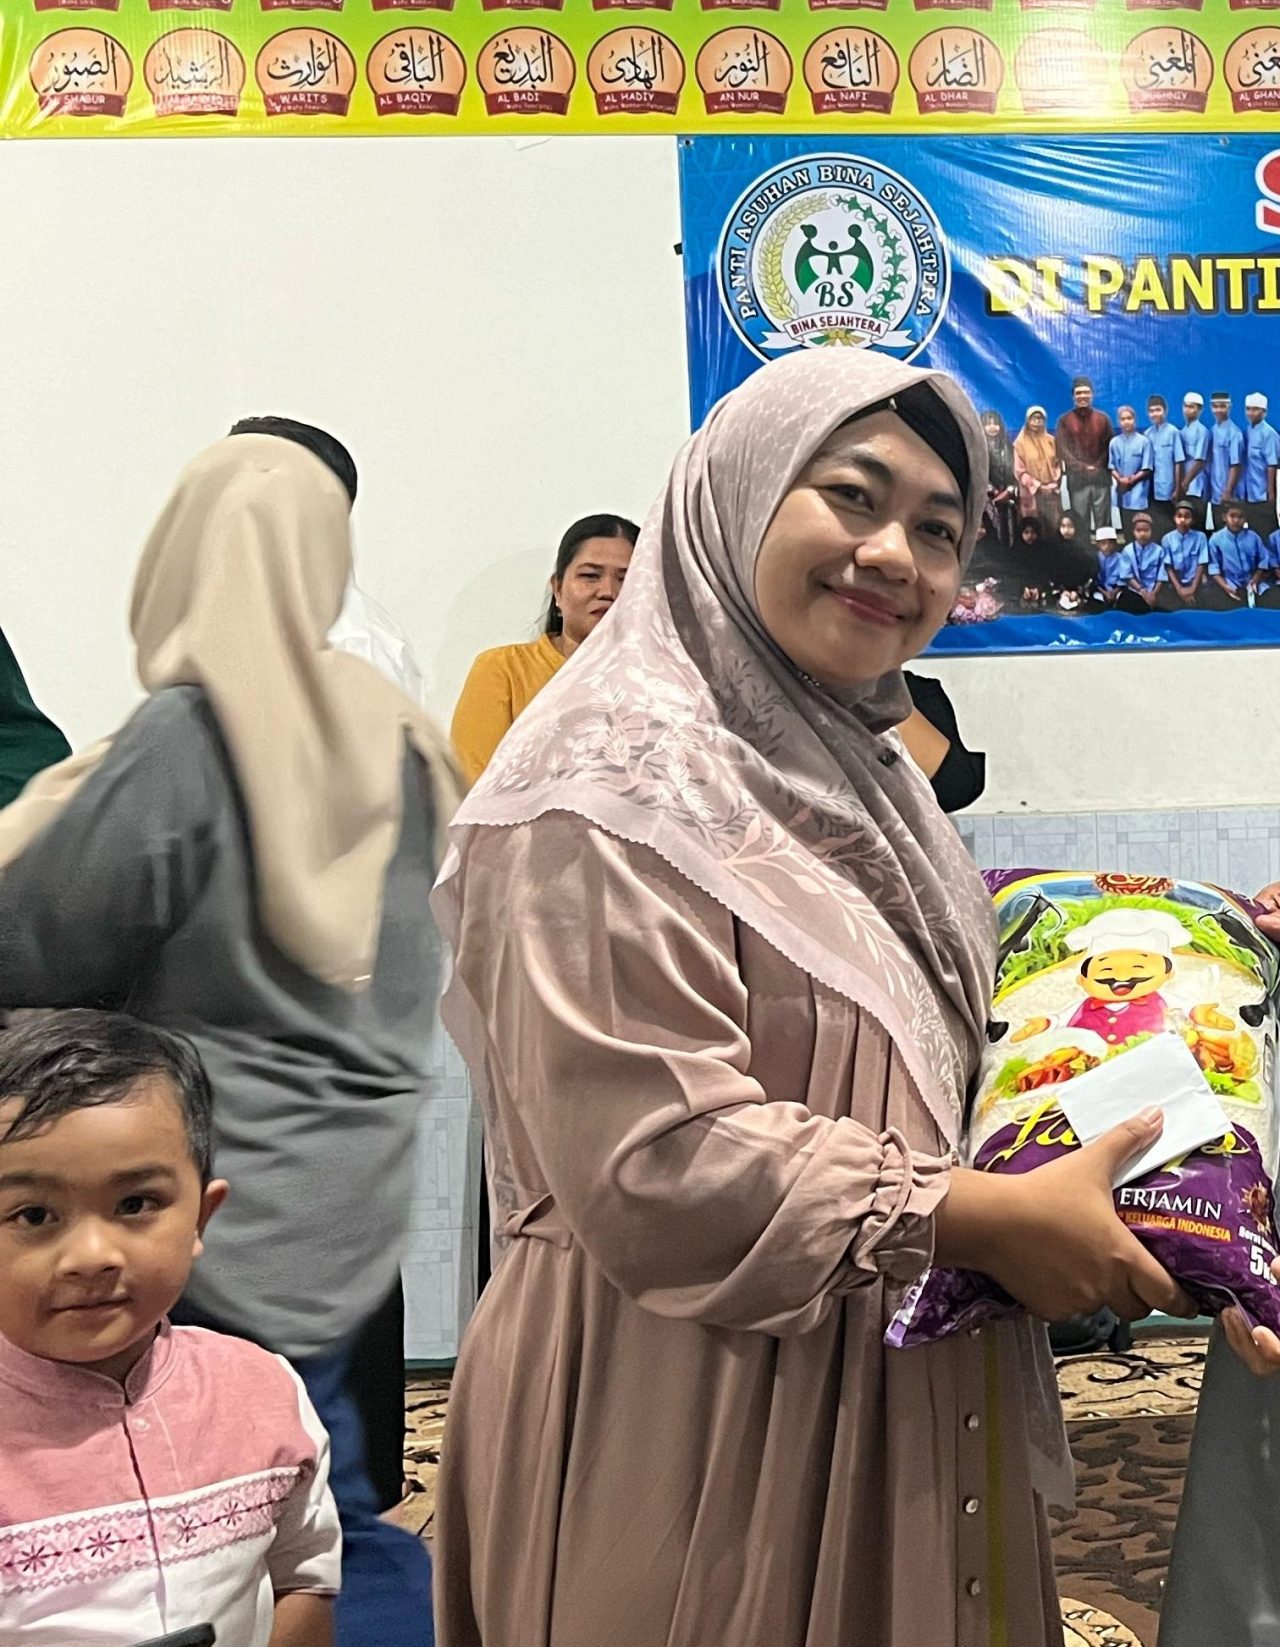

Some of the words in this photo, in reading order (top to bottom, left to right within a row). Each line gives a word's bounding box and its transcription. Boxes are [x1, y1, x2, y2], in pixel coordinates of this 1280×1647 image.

[497, 94, 510, 103] AL
[605, 94, 617, 103] AL
[720, 93, 735, 101] AN
[738, 92, 760, 101] NUR
[824, 93, 837, 102] AL
[925, 94, 937, 102] AL
[941, 91, 968, 101] DHAR
[1239, 93, 1250, 101] AL
[818, 165, 875, 189] BINA
[734, 168, 812, 244] ASUHAN
[879, 184, 940, 316] SEJAHTERA
[729, 247, 757, 321] PANTI
[989, 257, 1064, 313] DI
[790, 321, 818, 336] BINA
[819, 317, 883, 335] SEJAHTERA
[1119, 1187, 1222, 1220] ERJAMIN
[1125, 1212, 1176, 1231] KELUARGA
[1177, 1218, 1231, 1242] INDONESIA
